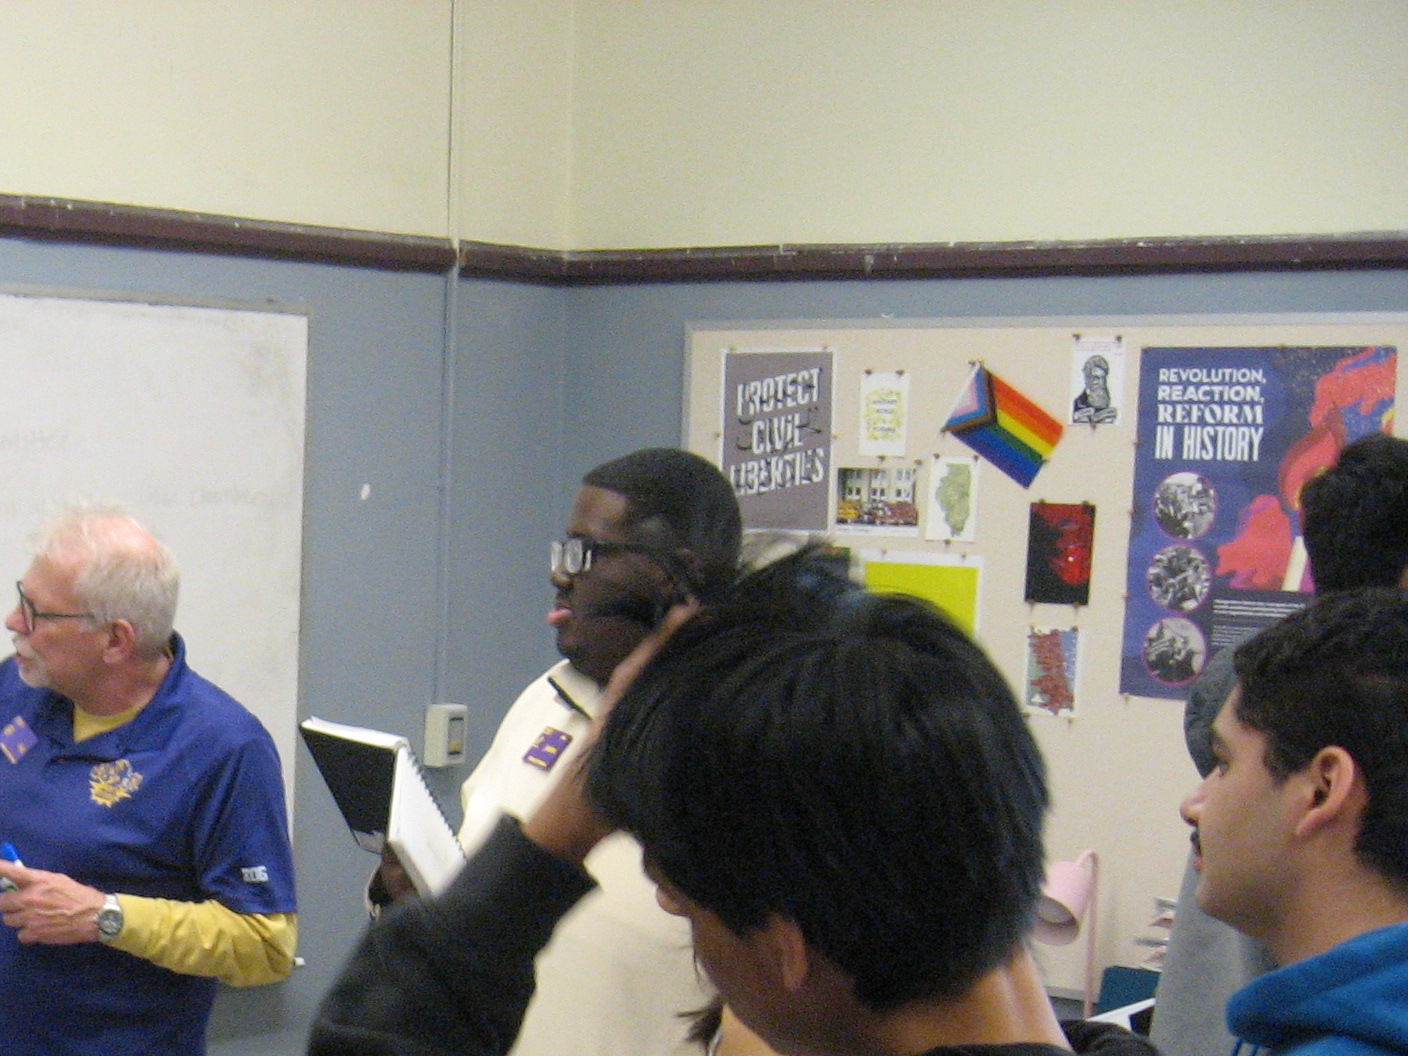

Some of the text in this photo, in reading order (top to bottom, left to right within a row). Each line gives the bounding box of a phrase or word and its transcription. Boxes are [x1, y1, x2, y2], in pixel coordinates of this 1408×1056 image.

[736, 367, 822, 417] PROTECT
[1158, 367, 1267, 384] REVOLUTION,
[1157, 384, 1265, 404] REACTION,
[1156, 403, 1264, 425] REFORM
[752, 413, 805, 455] CIVIL
[1154, 425, 1265, 461] IN HISTORY
[729, 448, 825, 497] LIBERTIES
